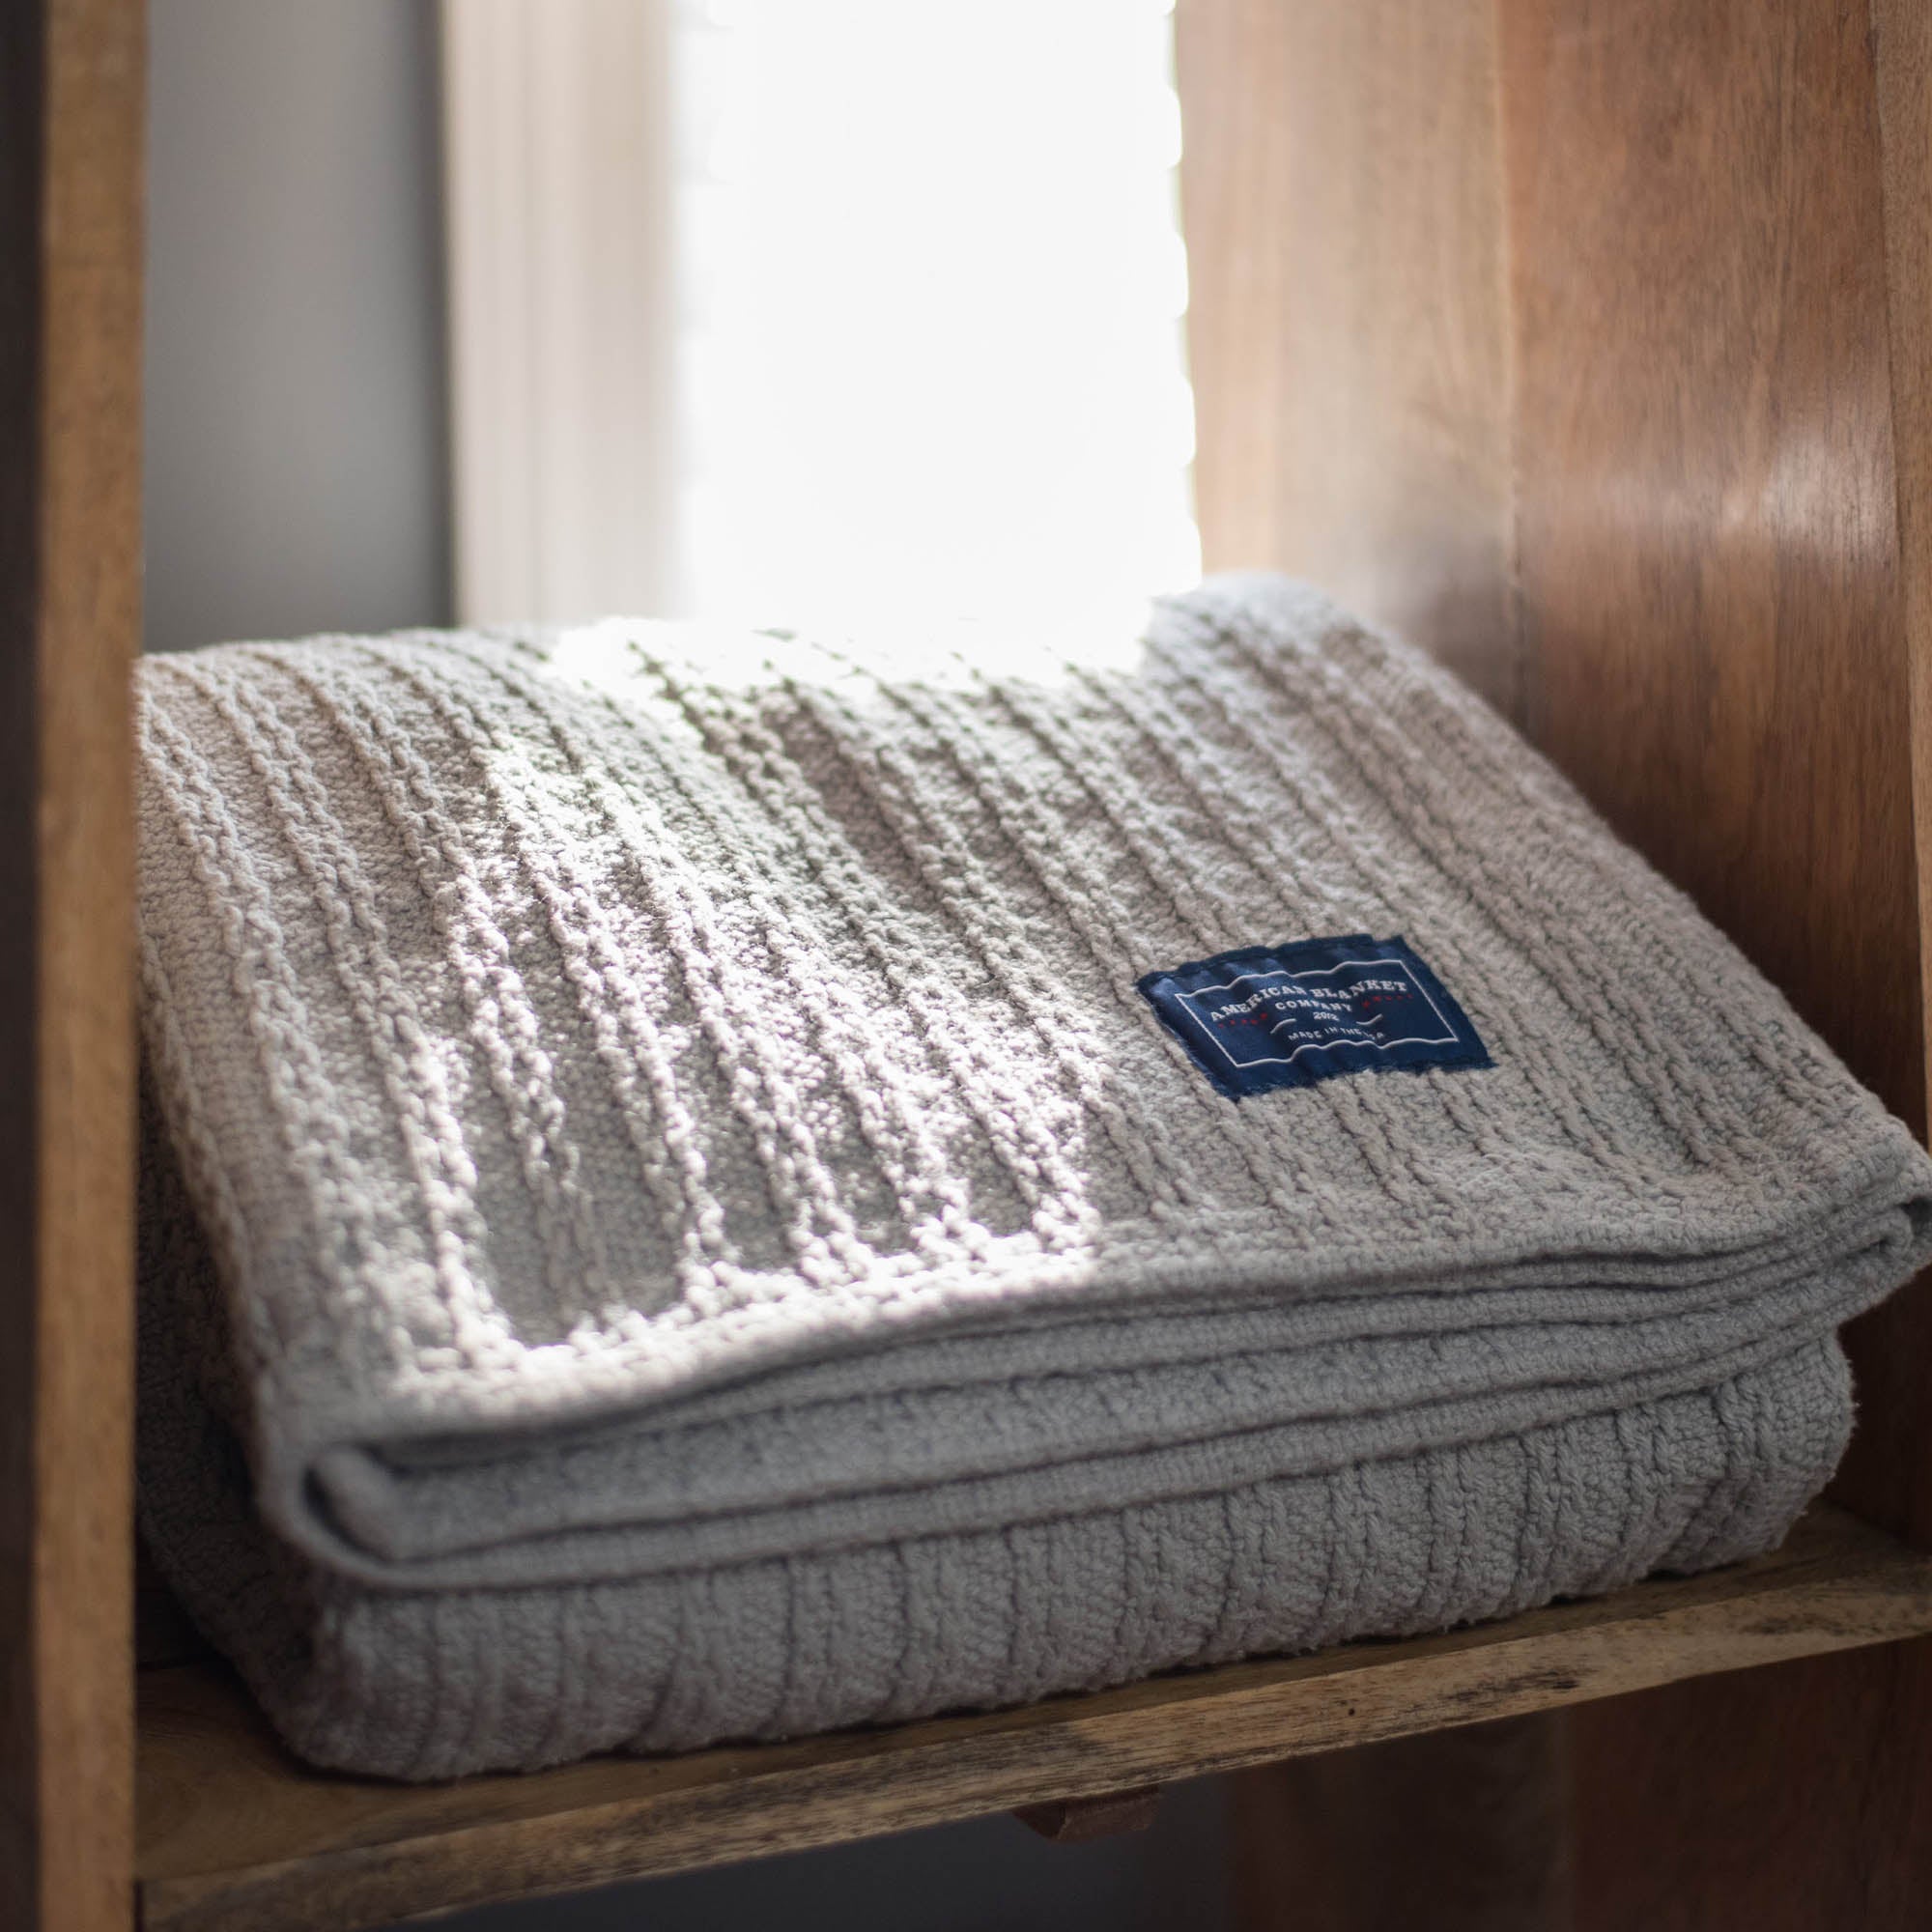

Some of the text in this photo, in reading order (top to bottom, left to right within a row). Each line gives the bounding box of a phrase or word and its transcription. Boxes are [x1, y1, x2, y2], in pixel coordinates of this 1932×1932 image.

[1210, 980, 1407, 1021] AMERICAN BLANKET
[1275, 999, 1352, 1012] COMPANY
[1313, 1011, 1340, 1021] 2012
[1288, 1030, 1322, 1040] MADE
[1324, 1026, 1338, 1035] IN
[1340, 1027, 1362, 1036] THE
